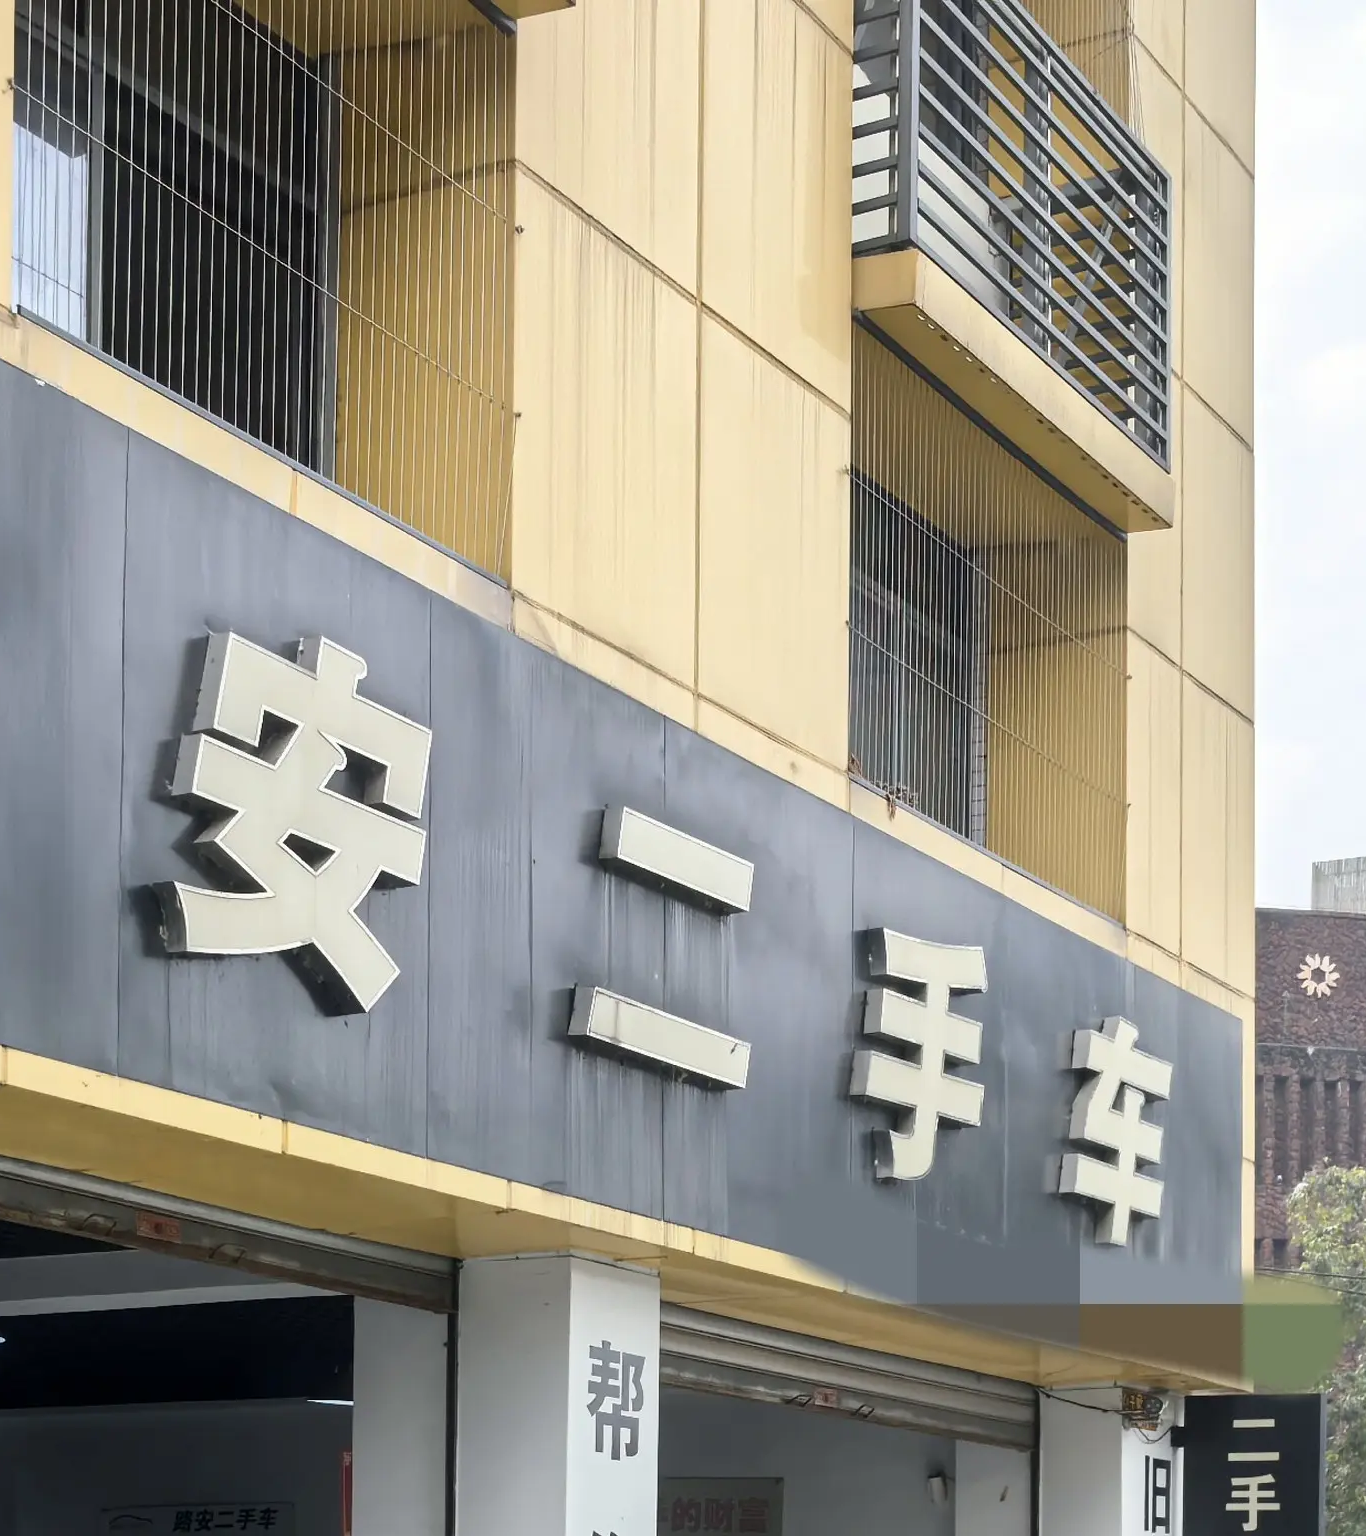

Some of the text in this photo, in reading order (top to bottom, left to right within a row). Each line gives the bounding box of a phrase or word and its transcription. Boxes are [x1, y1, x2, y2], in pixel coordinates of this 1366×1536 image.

[172, 1507, 279, 1532] 路安二手车
[659, 1496, 770, 1534] 的财富
